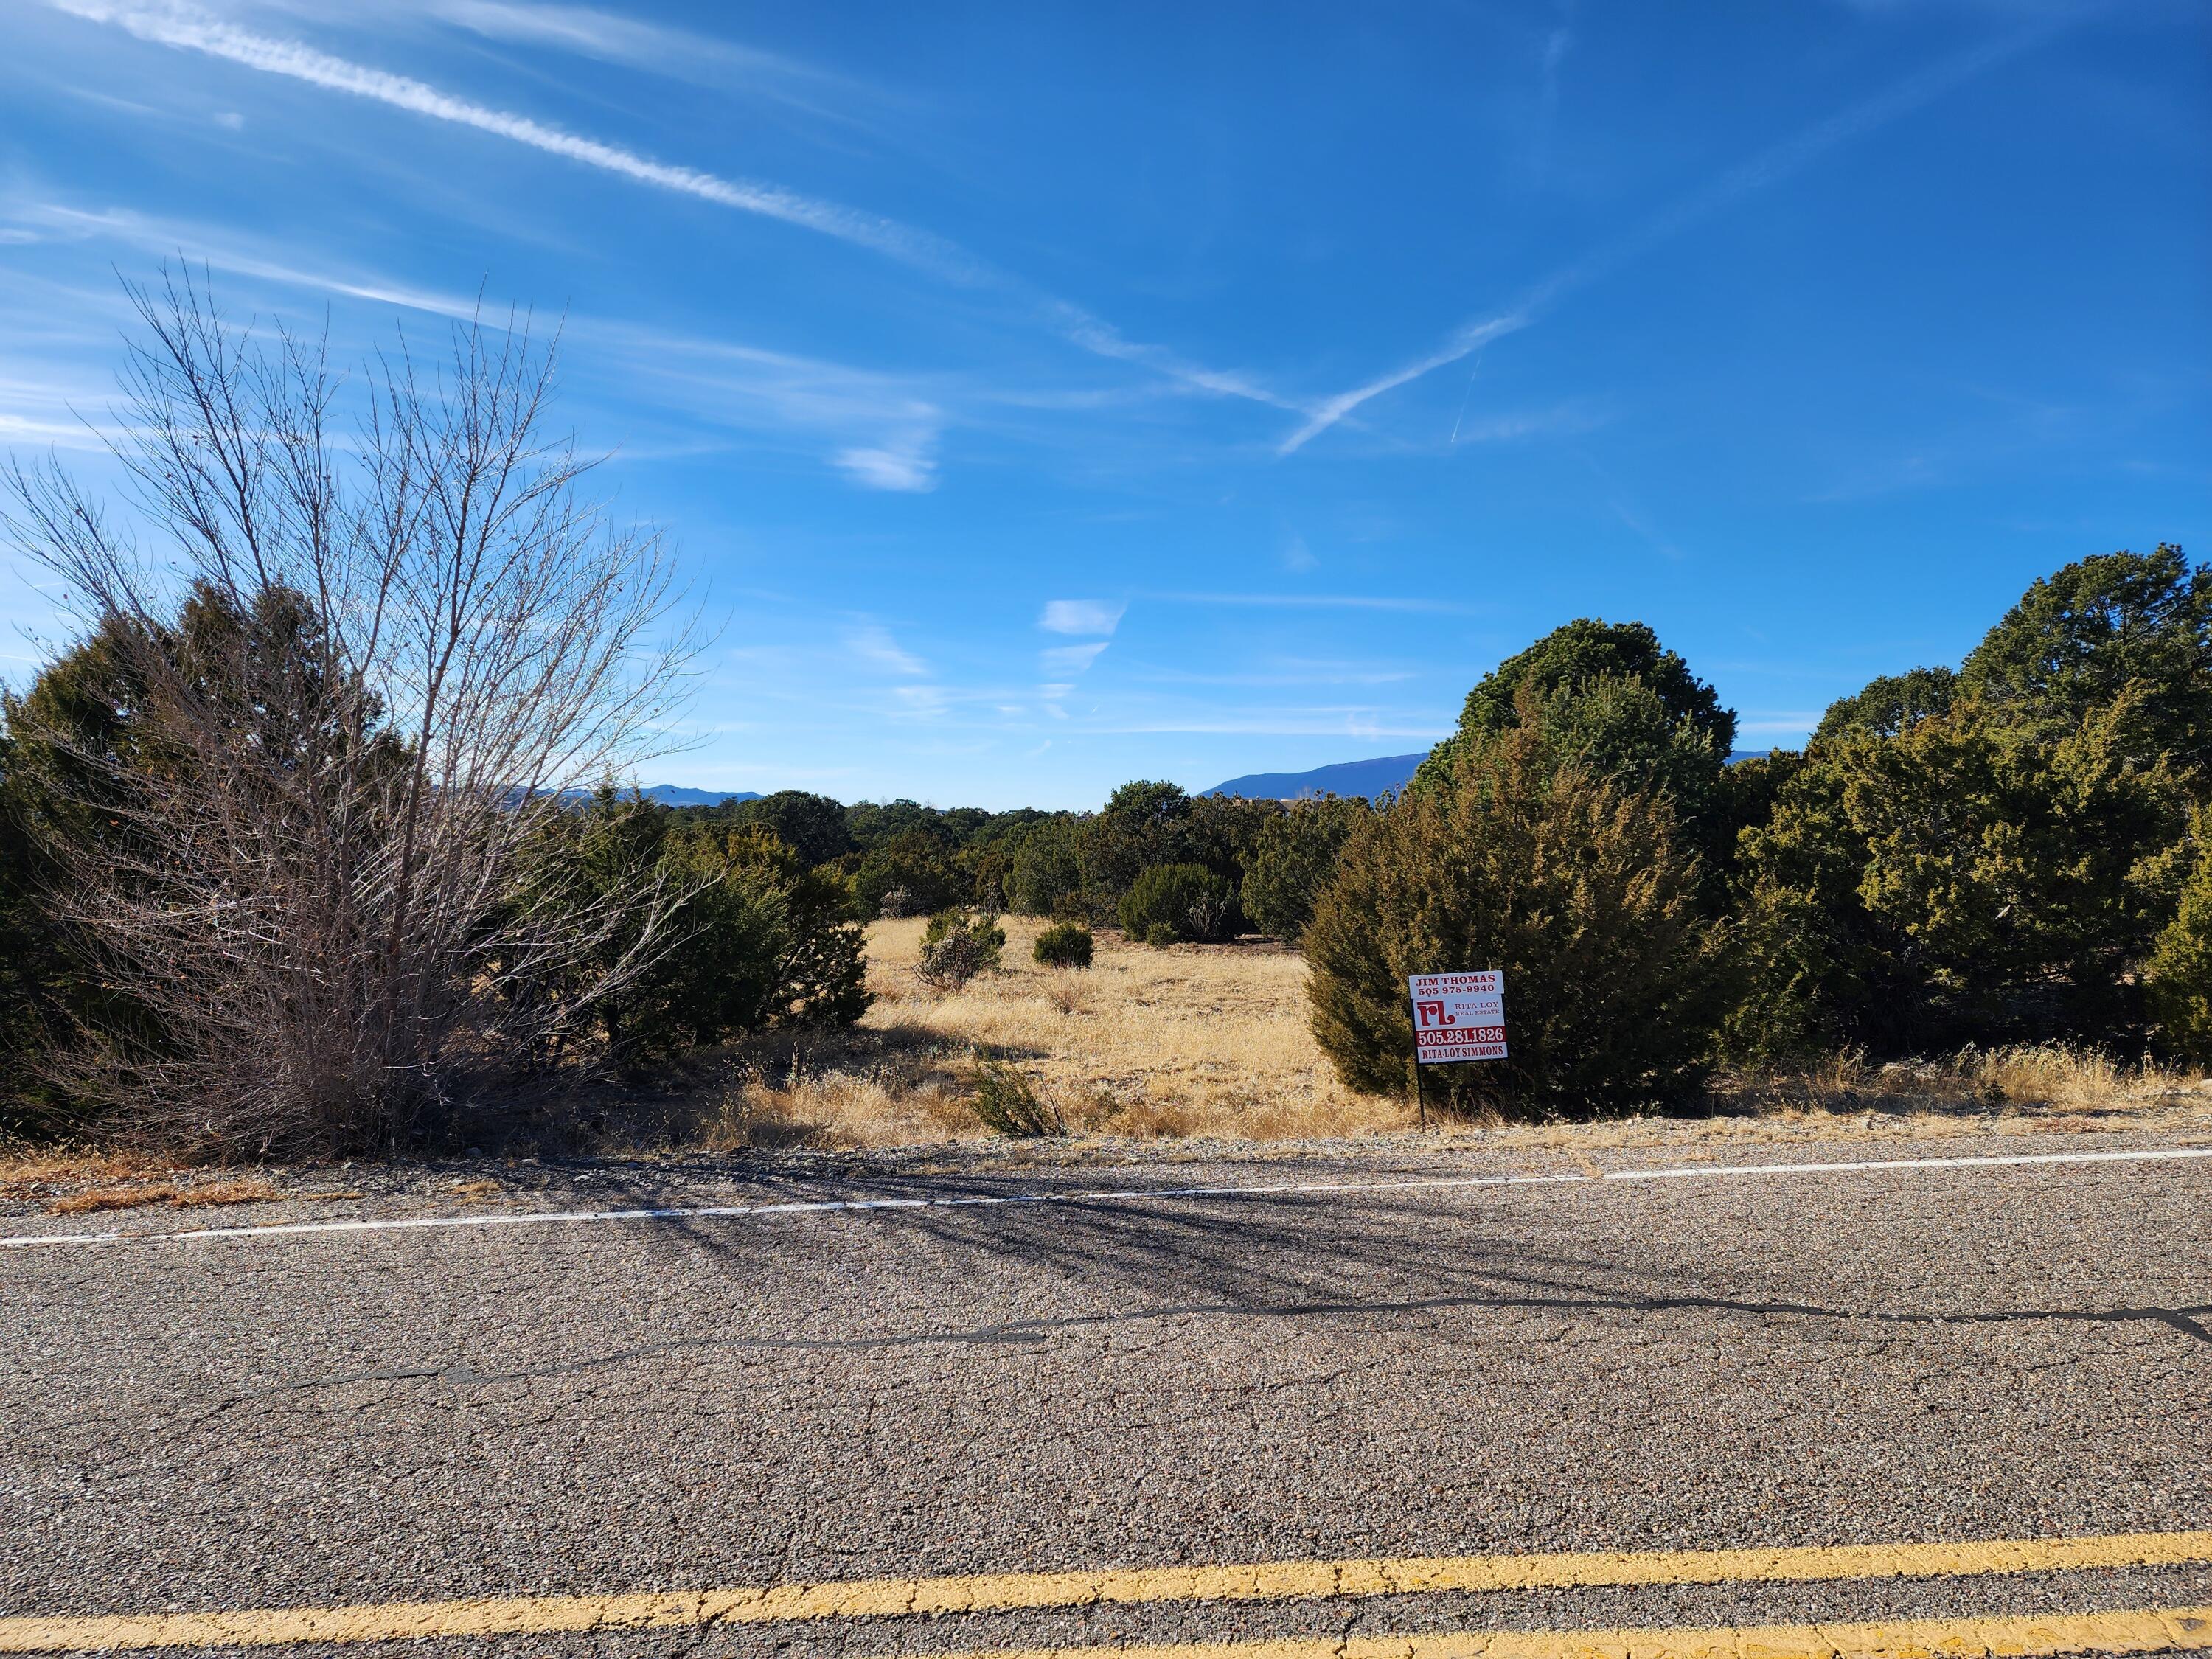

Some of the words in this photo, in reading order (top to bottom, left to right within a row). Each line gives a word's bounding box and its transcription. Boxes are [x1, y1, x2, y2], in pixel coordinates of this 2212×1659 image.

[1416, 978, 1439, 987] JIM
[1441, 975, 1495, 985] THOMAS
[1419, 987, 1439, 995] 505
[1442, 984, 1495, 994] 975-9940
[1419, 1028, 1503, 1046] 505.281.1826
[1462, 1046, 1503, 1057] SIMMONS
